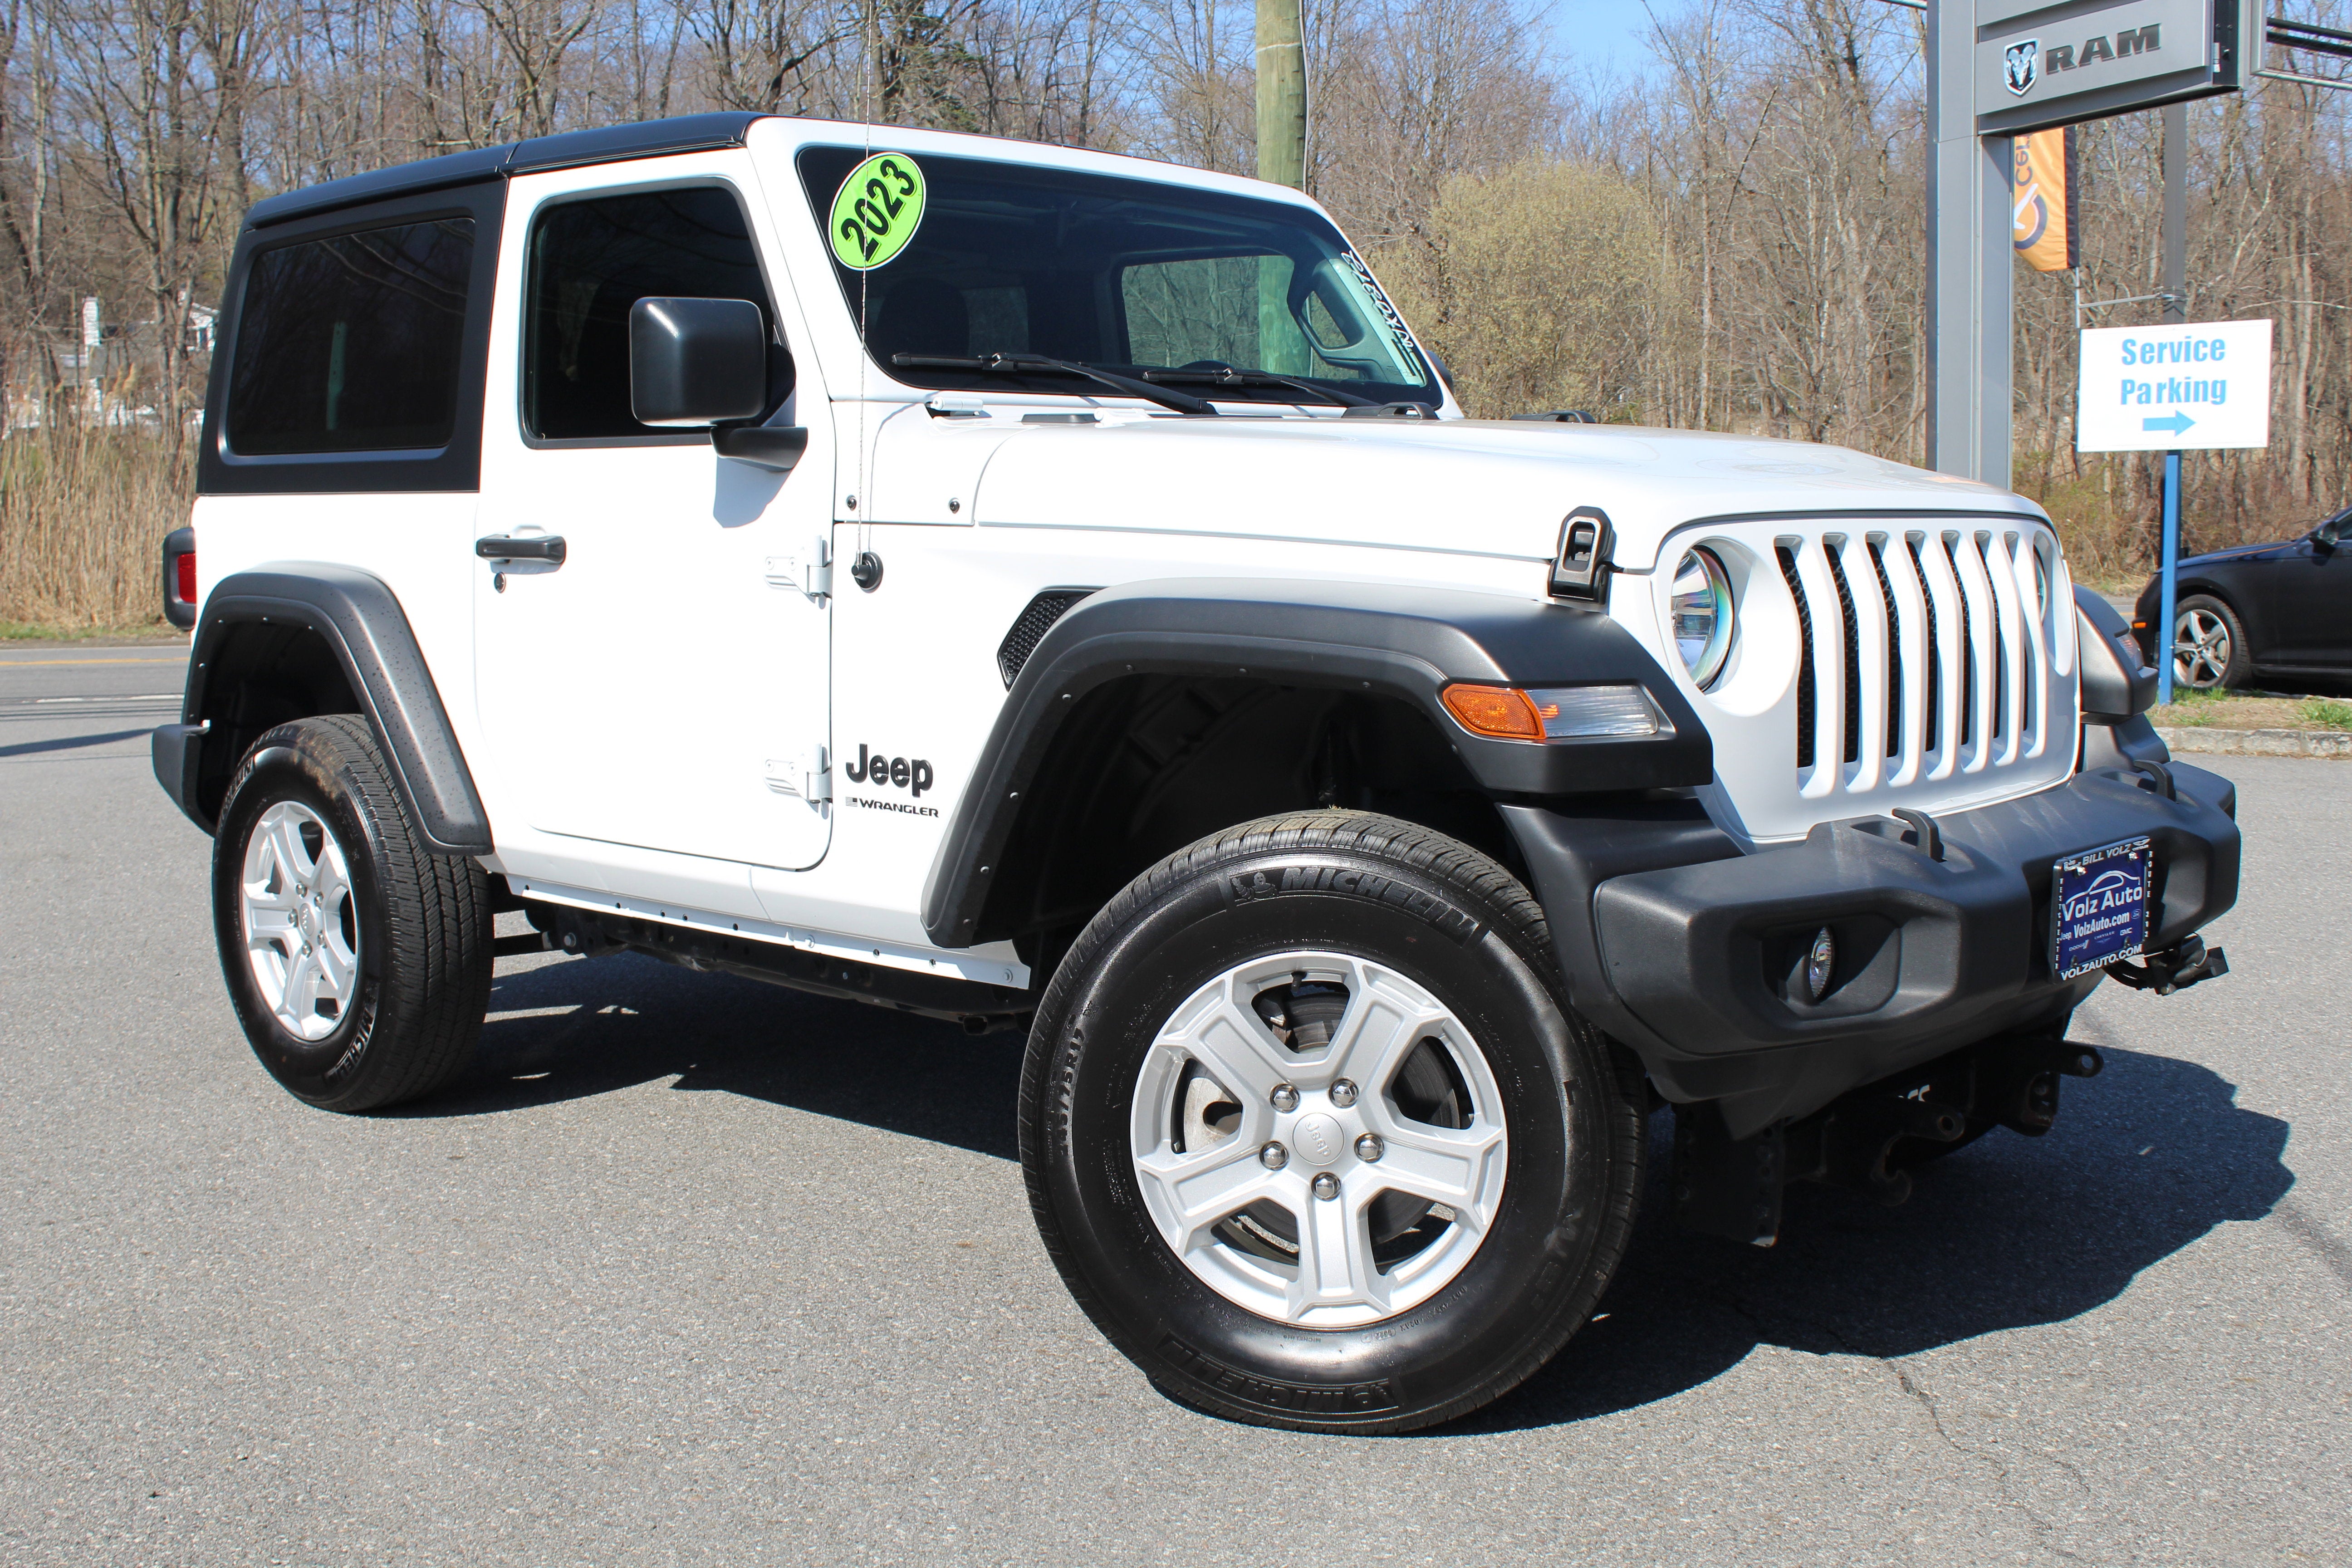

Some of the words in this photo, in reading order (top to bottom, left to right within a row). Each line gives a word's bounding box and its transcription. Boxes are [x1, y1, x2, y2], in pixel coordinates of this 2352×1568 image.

[2046, 23, 2161, 75] RAM
[841, 159, 917, 263] 2023
[2121, 336, 2226, 365] Service
[2120, 377, 2227, 405] Parking
[846, 743, 933, 798] Jeep
[859, 798, 939, 818] WRANGLER
[2082, 852, 2104, 865] BILL
[2107, 844, 2132, 858] VOLZ
[1281, 867, 1478, 939] MICHELIN
[2062, 897, 2097, 921] Volz
[2101, 886, 2142, 910] Auto
[2060, 931, 2072, 941] Jeep
[2074, 912, 2129, 938] VolzAuto.com
[2120, 927, 2132, 936] GMC
[2061, 944, 2142, 980] VOLZAUTO.COM
[1305, 1121, 1331, 1156] Jeep
[1156, 1340, 1345, 1410] MICHELIN
